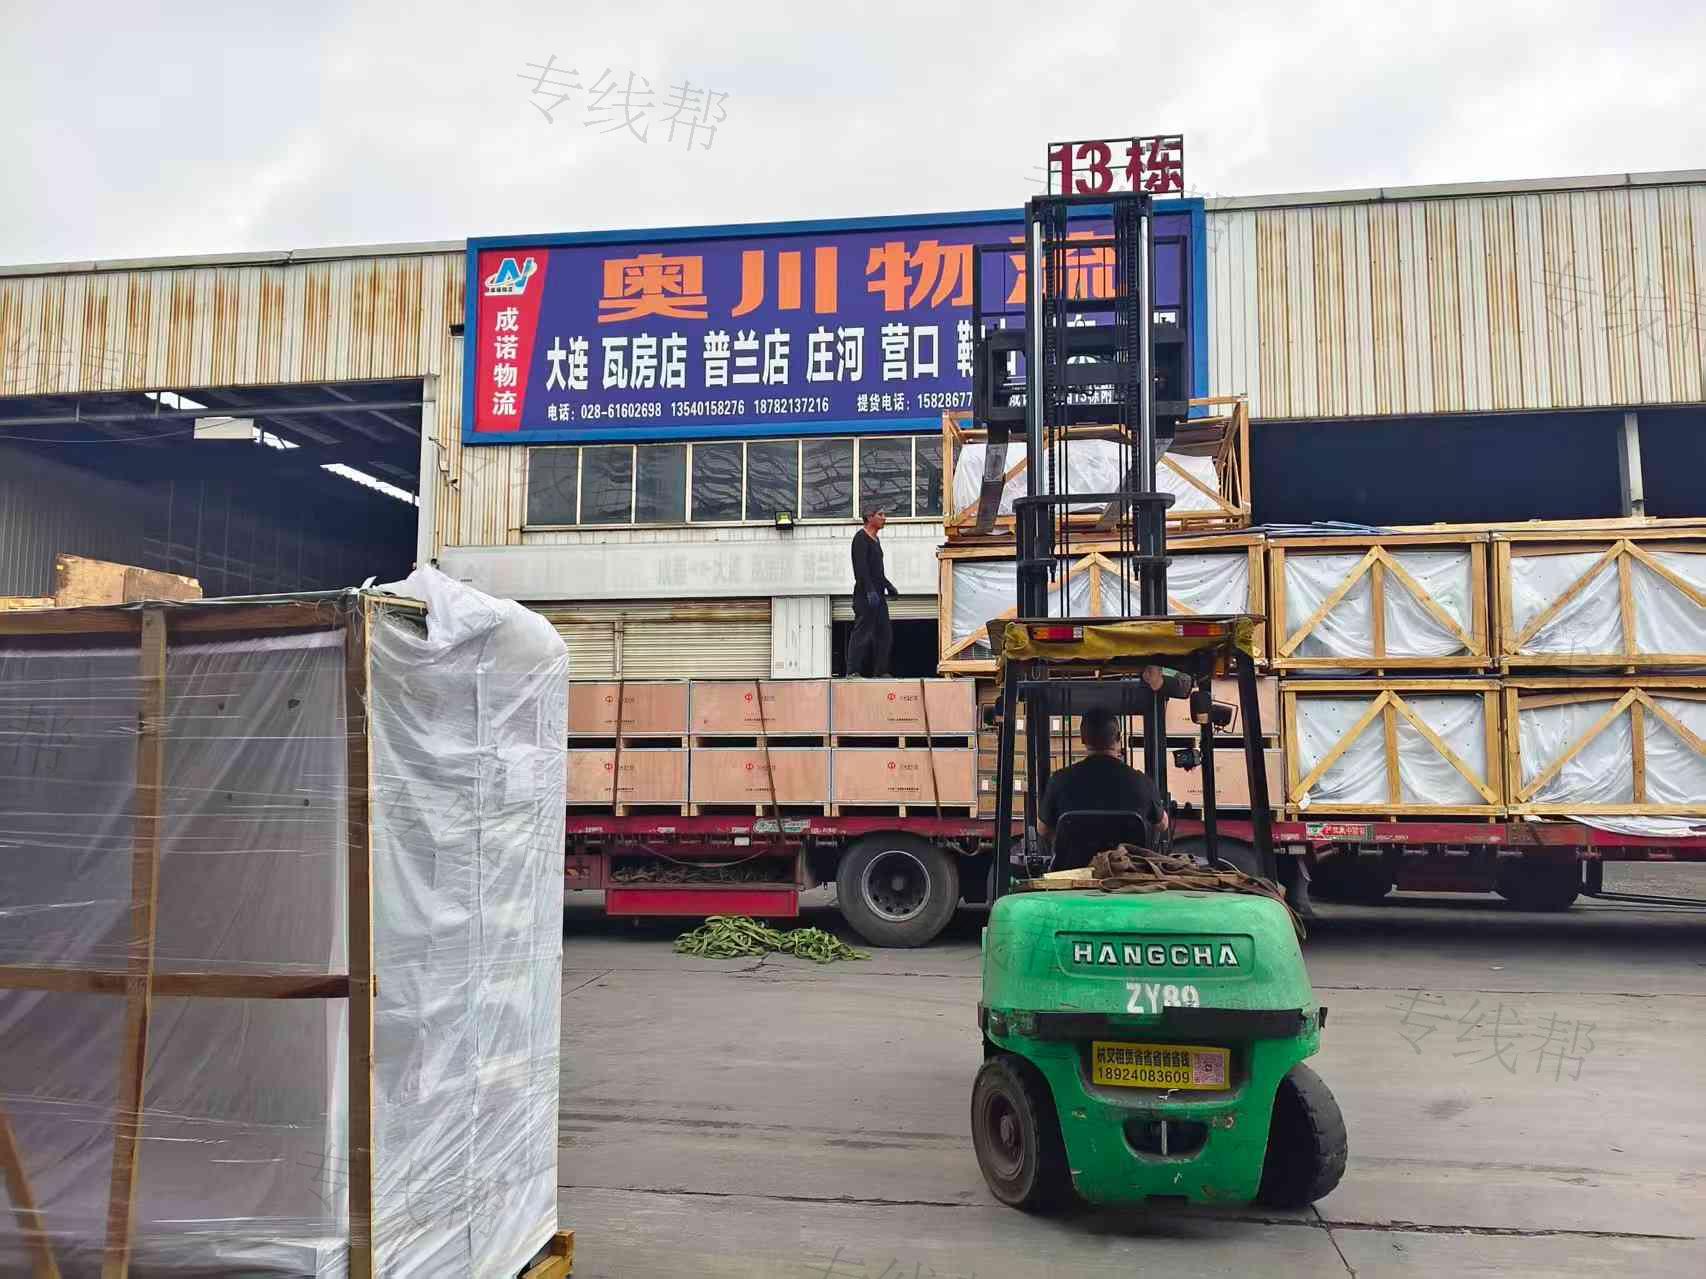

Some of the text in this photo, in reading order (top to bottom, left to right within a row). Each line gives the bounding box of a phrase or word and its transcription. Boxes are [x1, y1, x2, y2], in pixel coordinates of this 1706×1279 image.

[1049, 135, 1184, 197] 13栋
[492, 307, 519, 416] 成诺物流
[546, 335, 589, 392] 大连
[601, 332, 687, 390] 瓦房店
[703, 328, 790, 387] 普兰店
[806, 325, 865, 384] 庄河
[881, 322, 939, 381] 营口
[671, 399, 745, 417] 13540158276
[754, 397, 829, 415] 18782137216
[1072, 940, 1240, 967] HANGCHA
[1098, 1066, 1190, 1084] 18924083609
